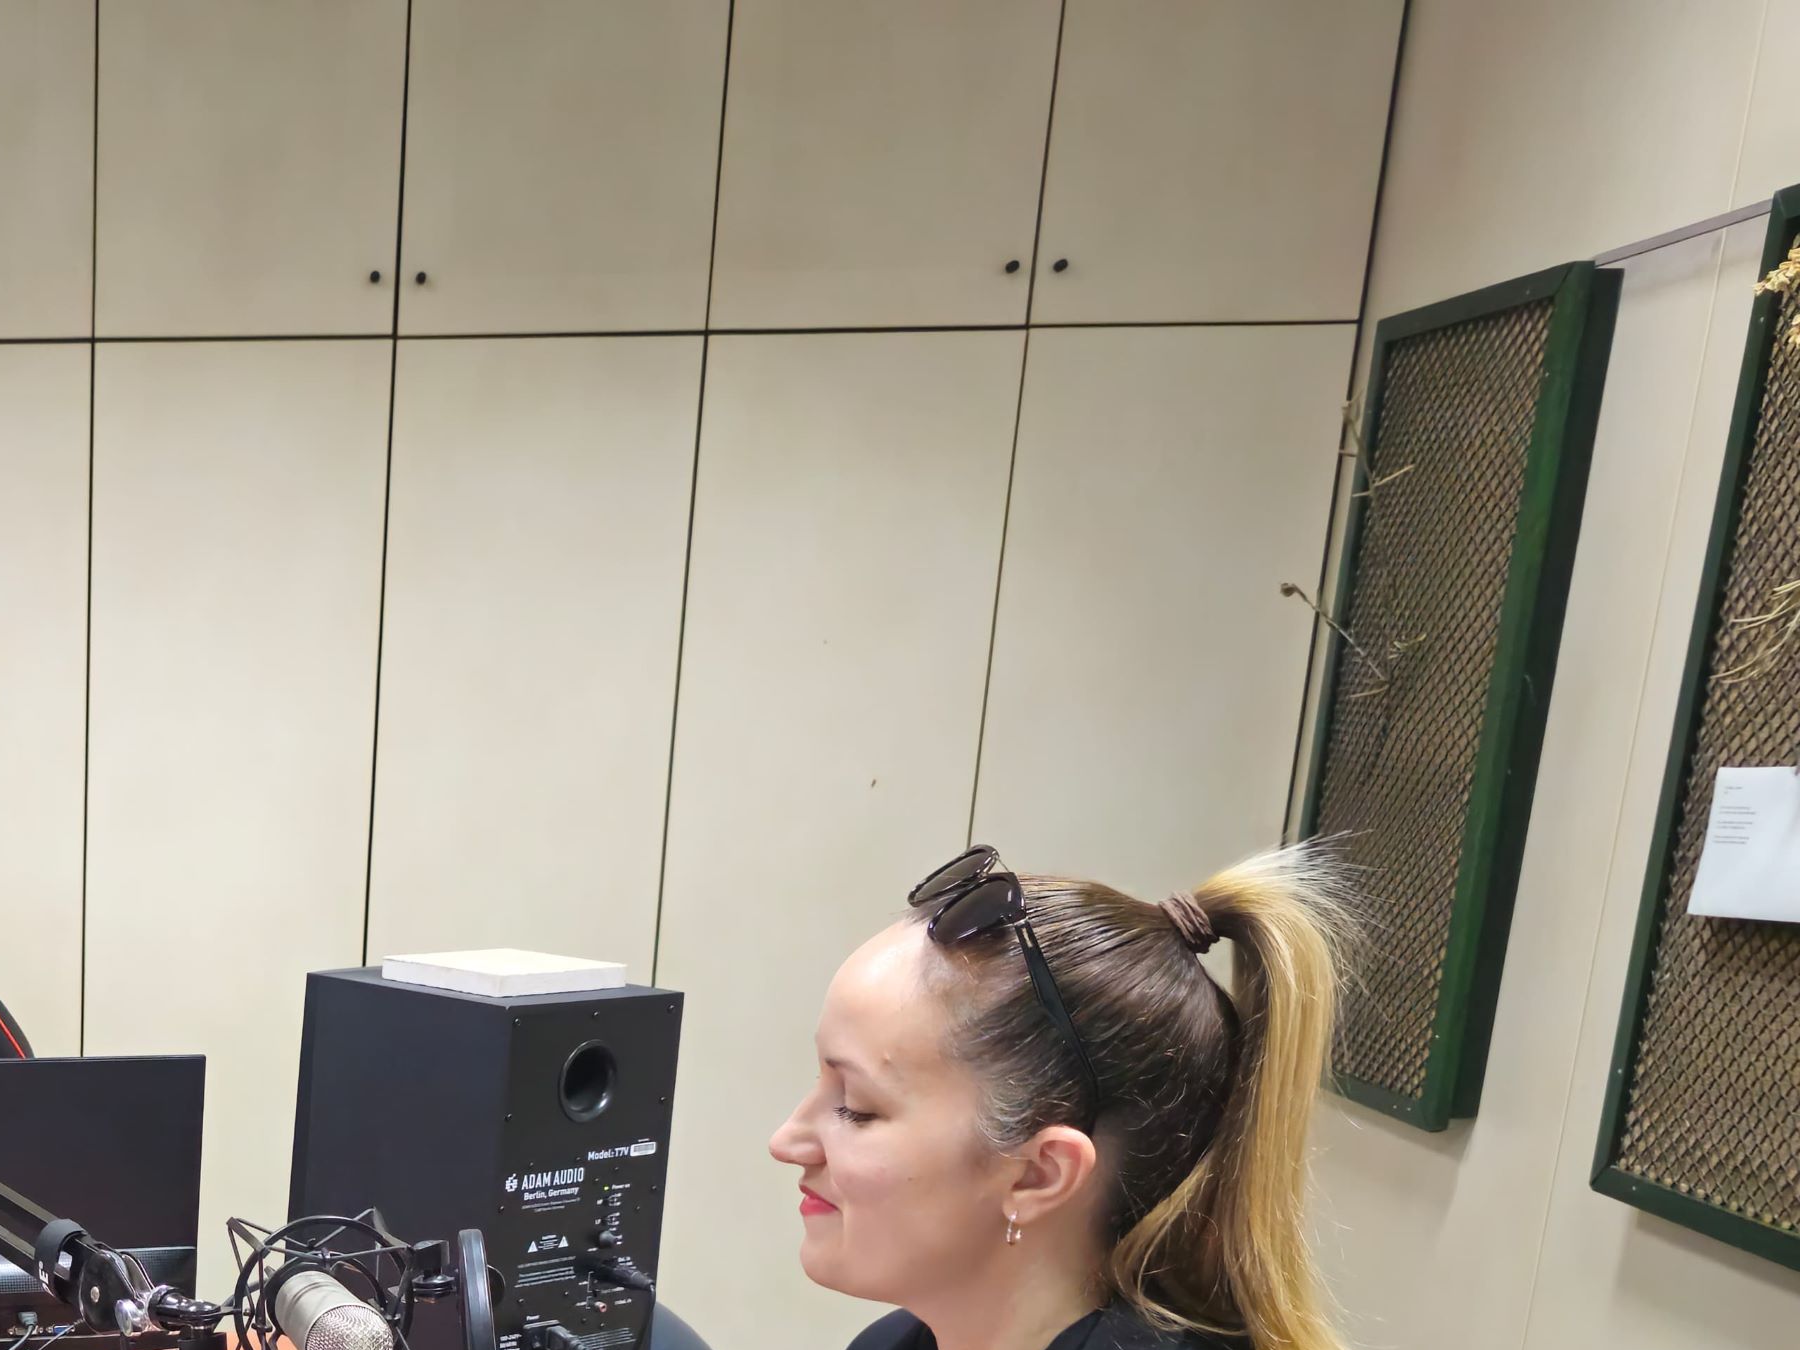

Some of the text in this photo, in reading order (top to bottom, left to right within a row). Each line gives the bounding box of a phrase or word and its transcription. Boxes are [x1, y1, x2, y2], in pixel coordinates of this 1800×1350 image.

[521, 1166, 585, 1191] ADAM AUDIO
[523, 1186, 580, 1201] Berlin, Germany
